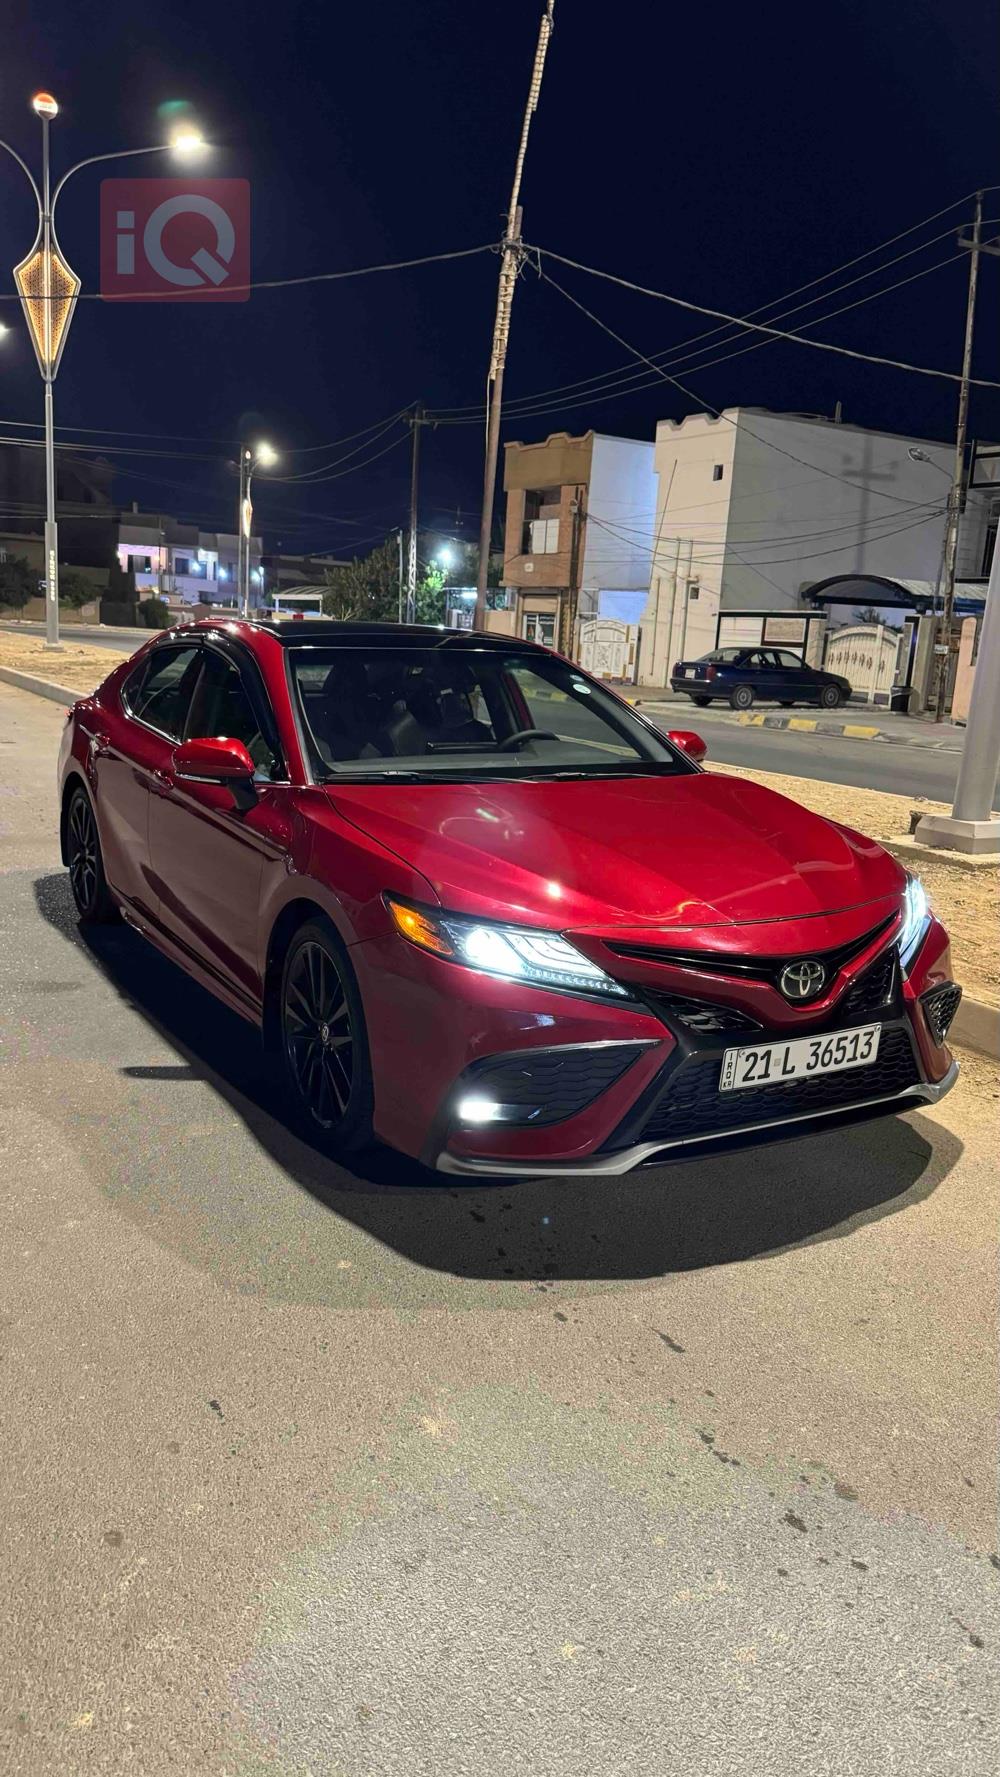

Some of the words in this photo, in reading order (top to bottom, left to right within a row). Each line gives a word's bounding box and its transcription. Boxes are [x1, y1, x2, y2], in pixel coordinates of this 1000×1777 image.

[742, 1049, 772, 1082] 21
[782, 1047, 795, 1076] L
[806, 1031, 875, 1070] 36513
